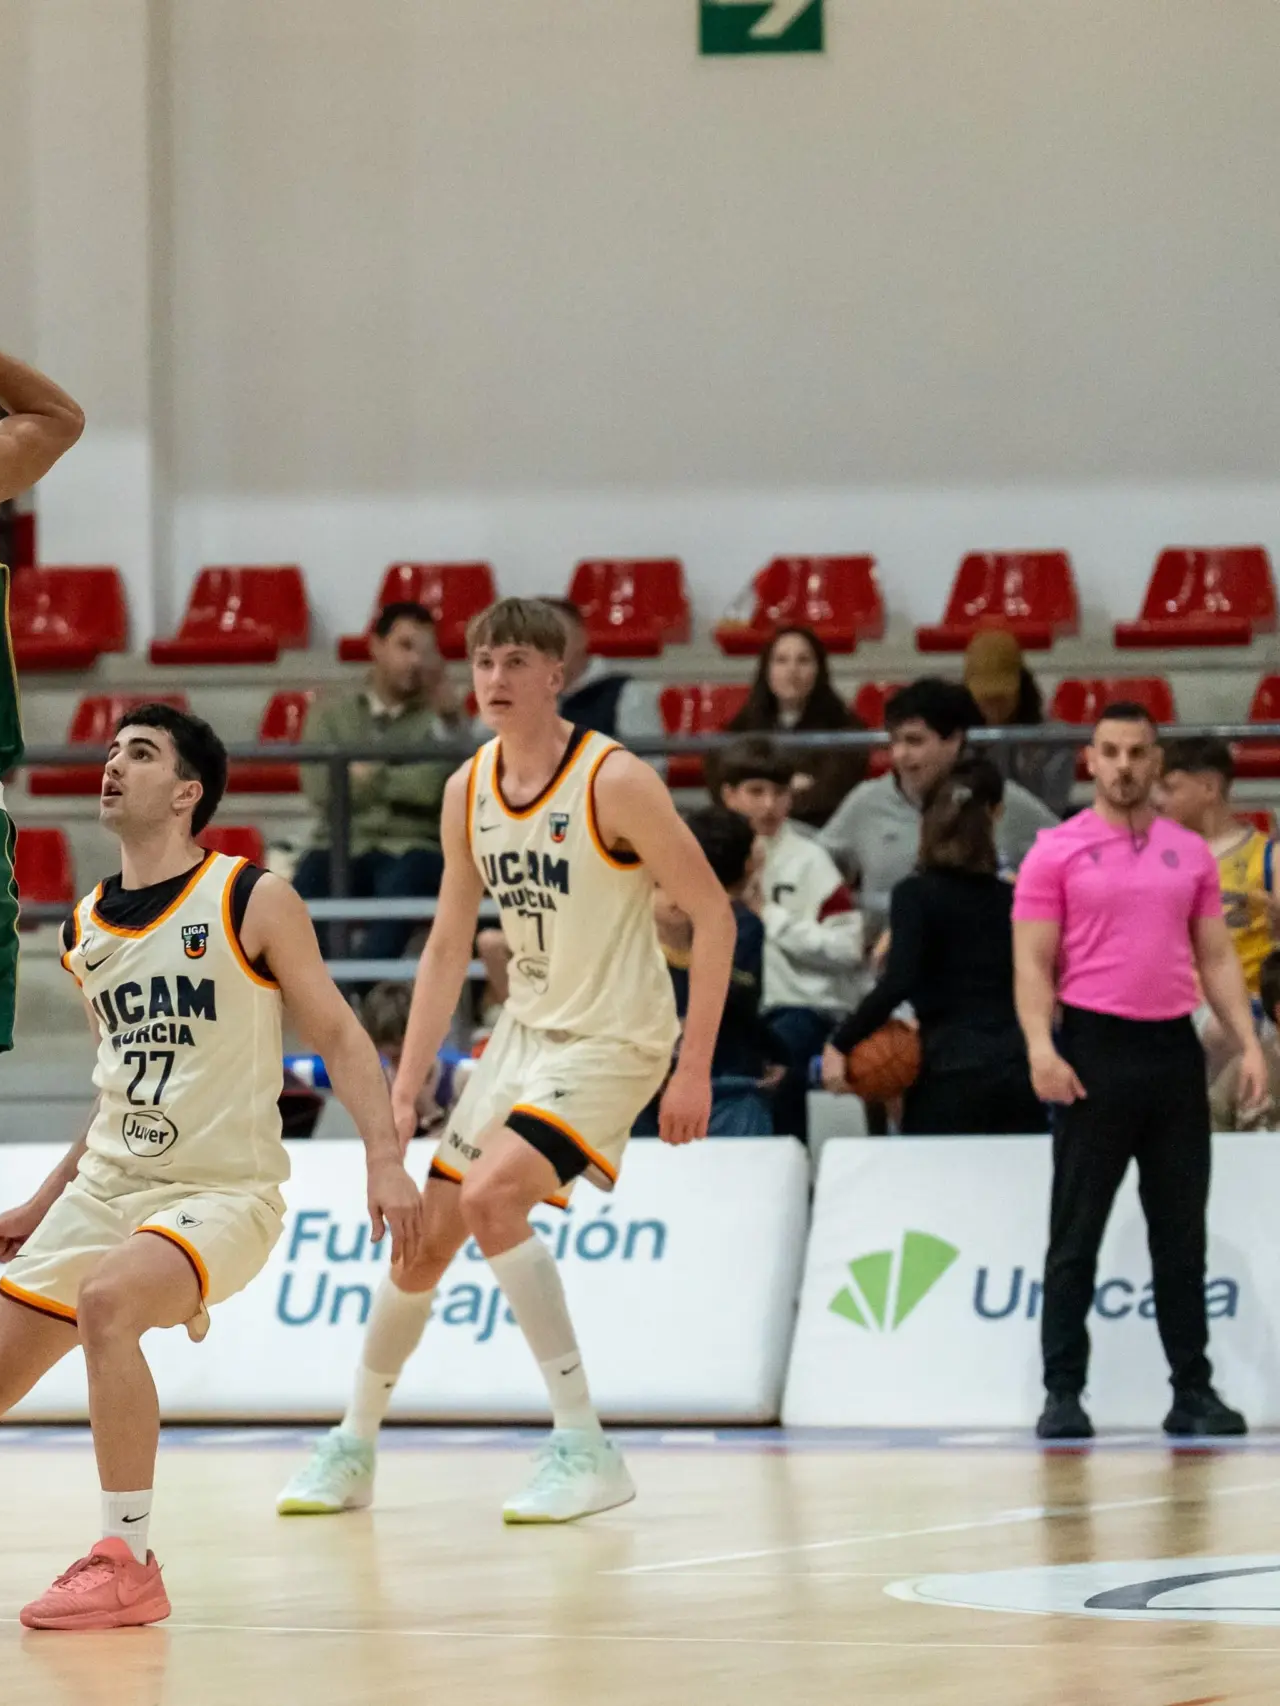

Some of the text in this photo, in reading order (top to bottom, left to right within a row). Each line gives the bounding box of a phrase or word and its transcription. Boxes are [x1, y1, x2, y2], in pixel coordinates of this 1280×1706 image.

[183, 925, 207, 936] LIGA
[91, 975, 218, 1035] UCAM
[123, 1050, 176, 1106] 27
[126, 1119, 170, 1145] Juver
